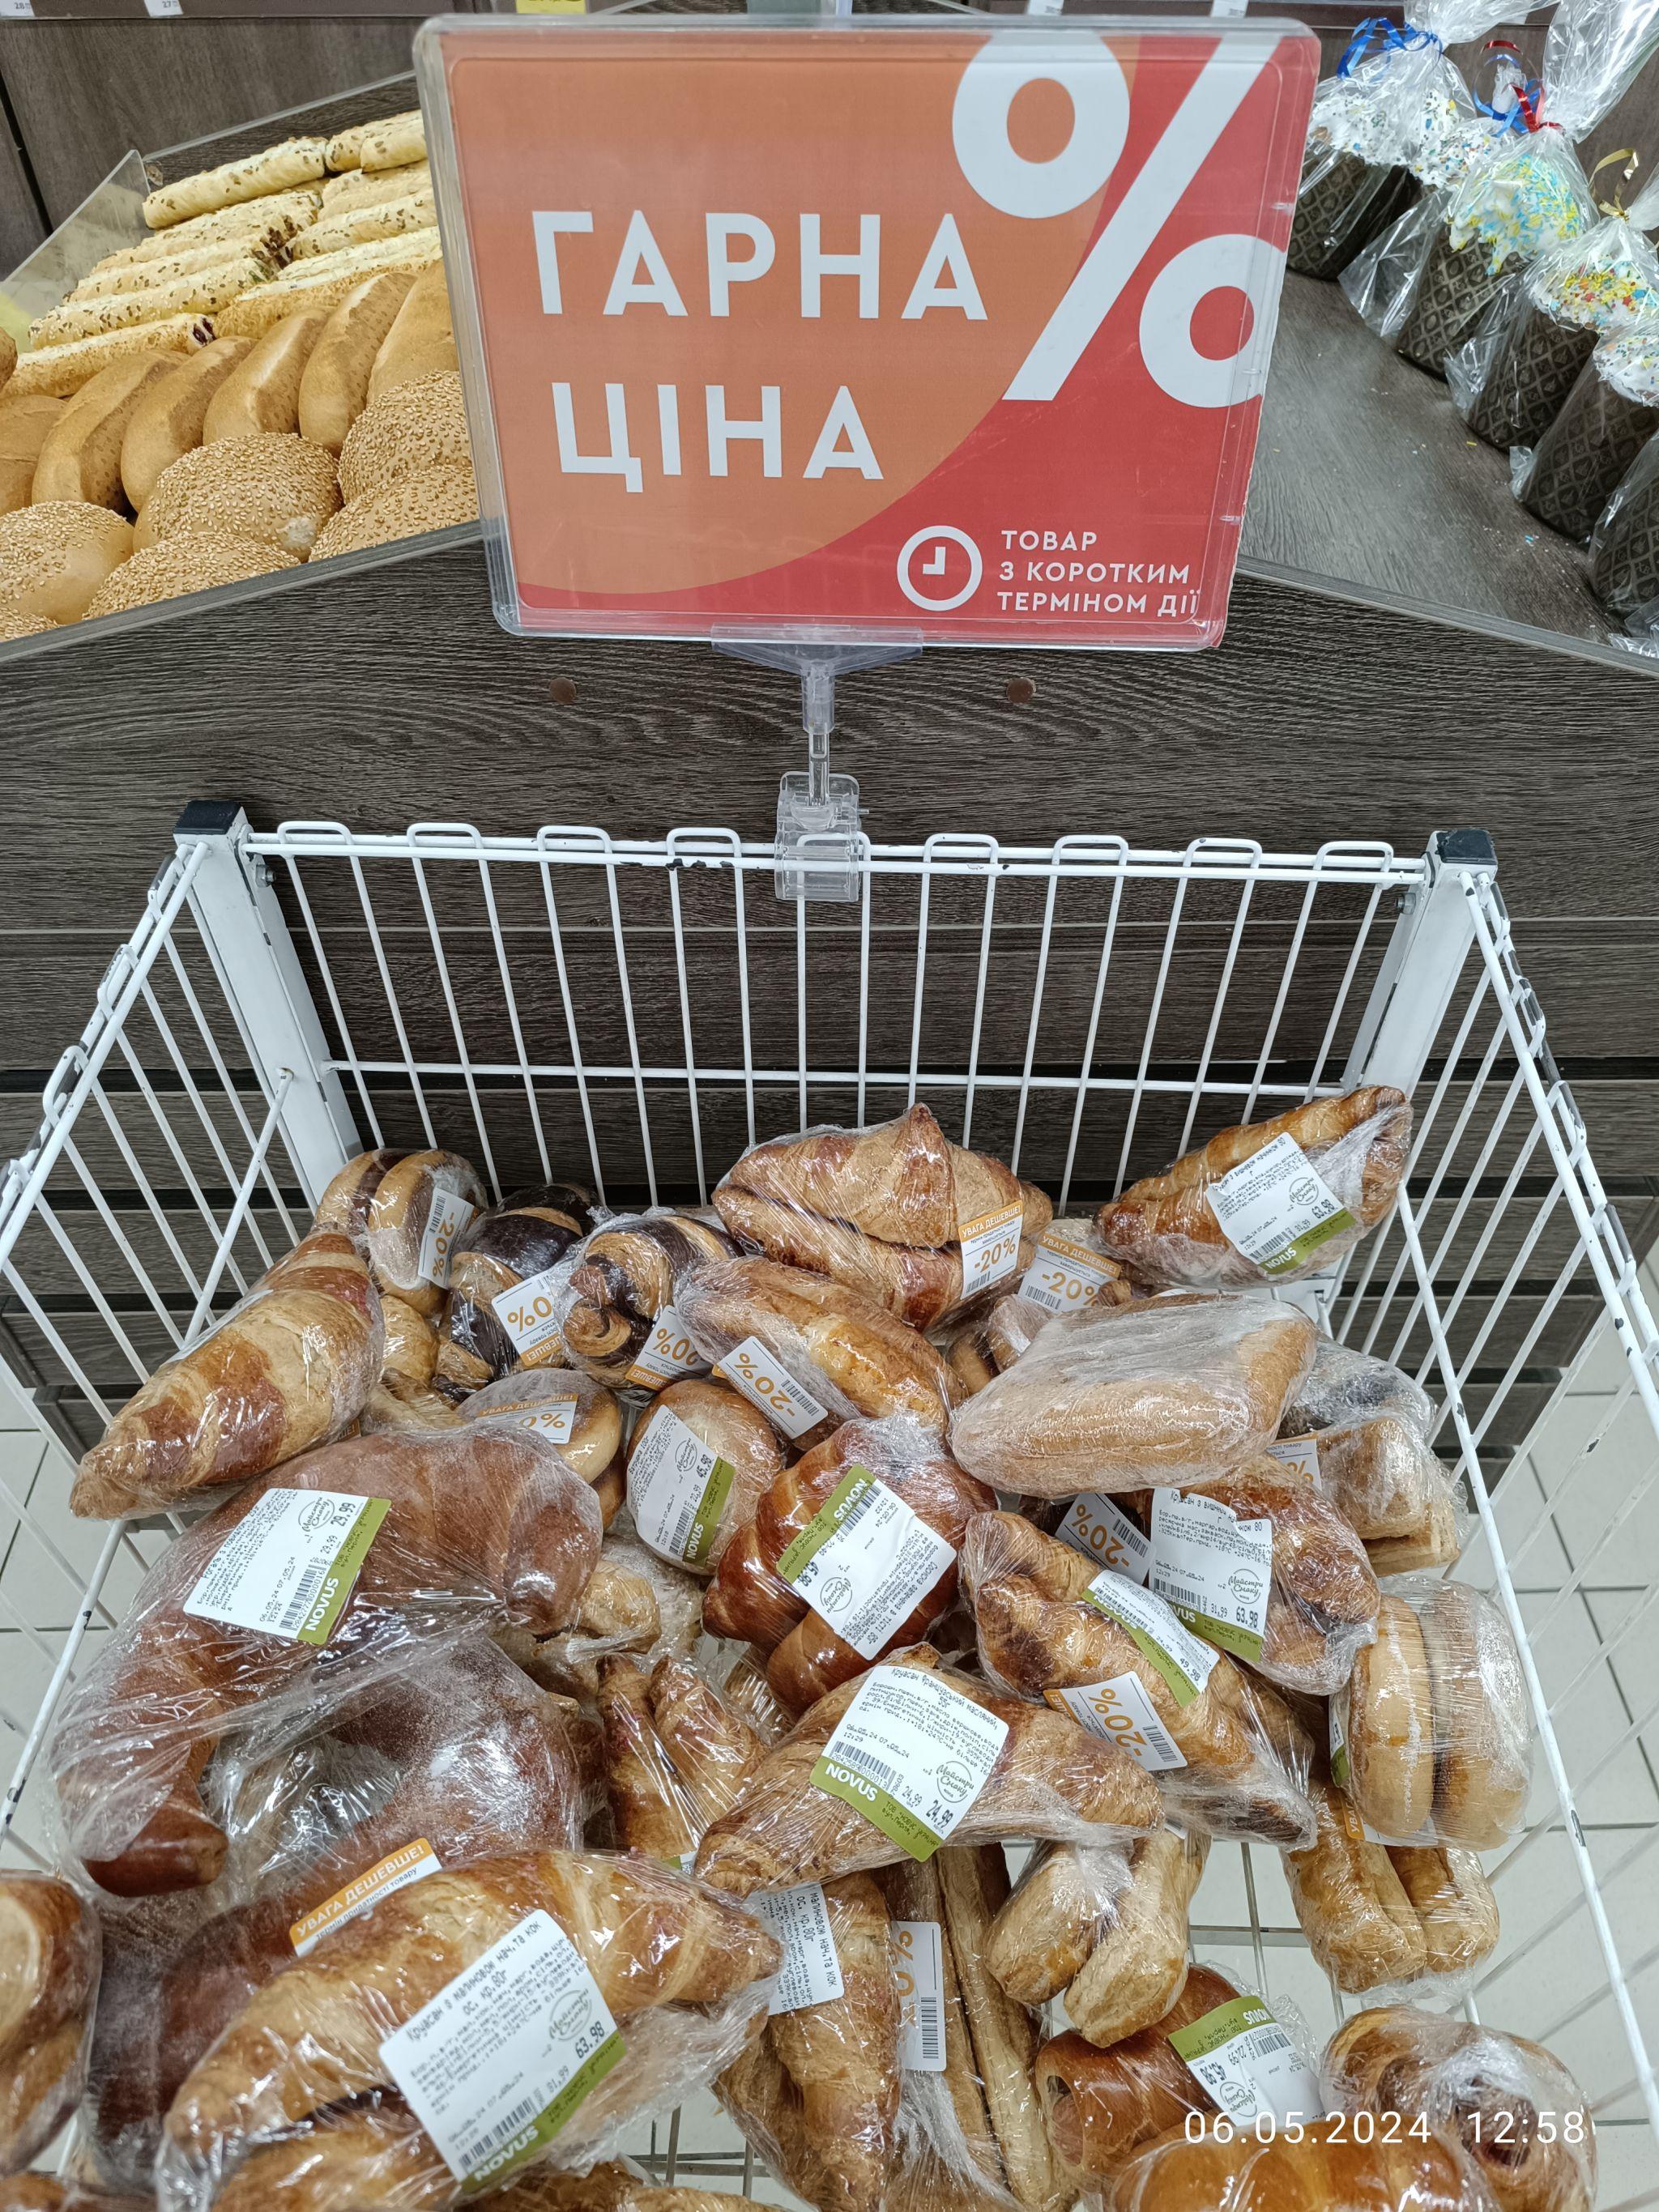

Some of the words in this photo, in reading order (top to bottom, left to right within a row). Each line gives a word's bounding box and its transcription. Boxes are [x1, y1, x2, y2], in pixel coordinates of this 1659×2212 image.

[531, 210, 988, 322] ГАРНА
[551, 381, 885, 494] ЦІНА
[1001, 528, 1098, 552] ТОВАР
[1000, 561, 1015, 582] З
[1026, 560, 1190, 585] КОРОТКИМ
[996, 590, 1147, 613] ТЕРМІНОМ
[1158, 590, 1198, 618] ДІЇ
[961, 1221, 984, 1238] УВАГА
[984, 1204, 1021, 1229] ДЕШЕВШЕ!
[1311, 1197, 1335, 1220] 63.98
[430, 1210, 457, 1278] -20%
[972, 1234, 1020, 1274] -20%
[1041, 1235, 1070, 1253] УВАГА
[1069, 1247, 1117, 1274] ДЕШЕВШЕ!
[1265, 1246, 1297, 1270] NOVUS
[1038, 1266, 1102, 1309] -20%
[505, 1293, 555, 1335] 0%
[650, 1326, 702, 1368] 20%
[730, 1351, 801, 1420] -20%
[481, 1404, 514, 1415] УВАГА
[518, 1413, 565, 1431] 0%
[300, 1495, 323, 1532] Майстри
[831, 1477, 868, 1521] NOVUS
[873, 1497, 889, 1515] 12:22
[309, 1500, 330, 1528] Смаку
[319, 1532, 338, 1555] 29.99
[330, 1498, 356, 1529] 29.99
[873, 1501, 896, 1528] 06.05.24
[685, 1521, 705, 1560] NOVUS
[1064, 1502, 1137, 1573] -20%
[795, 1558, 820, 1588] 45.98
[915, 1560, 938, 1586] Сосиска
[1227, 1575, 1263, 1589] Майстри
[258, 1589, 279, 1622] 06.05.24
[275, 1555, 296, 1589] 07.05.24
[821, 1579, 844, 1606] Смаку
[825, 1577, 852, 1613] Майстри
[893, 1583, 918, 1610] запечена
[1233, 1582, 1259, 1597] Смаку
[304, 1575, 340, 1633] NOVUS
[1175, 1607, 1196, 1622] VUS
[1235, 1606, 1260, 1628] 63.98
[875, 1614, 891, 1634] тісті
[1178, 1657, 1201, 1681] 49.98
[890, 1667, 919, 1681] Круасан
[920, 1674, 966, 1707] Французький
[937, 1696, 952, 1709] 55г
[843, 1731, 864, 1743] 12:29
[1088, 1685, 1150, 1760] -20%
[825, 1762, 880, 1802] NOVUS
[935, 1762, 975, 1791] Майстри
[939, 1774, 967, 1798] Смаку
[885, 1801, 897, 1813] ТОВ
[901, 1784, 923, 1808] 24.99
[924, 1797, 953, 1831] 24.99
[296, 1899, 343, 1937] УВАГА
[342, 1843, 424, 1905] ДЕШЕВШЕ!
[342, 1884, 390, 1921] придатності
[389, 1866, 419, 1888] товару
[795, 1895, 807, 1909] ос.
[809, 1891, 825, 1935] малиновою
[797, 1914, 817, 1943] кр.80г
[819, 1937, 832, 1967] нач.та
[405, 2005, 445, 2044] Круасан
[452, 1958, 497, 2001] малиновою
[495, 1933, 526, 1963] нач.та
[524, 1919, 542, 1937] кок
[825, 1971, 837, 1987] кок
[461, 1997, 480, 2016] ос.
[1242, 2006, 1270, 2025] NOVUS
[571, 2020, 608, 2059] 63.98
[1226, 2044, 1247, 2066] 22.99
[1199, 2060, 1227, 2087] 45.98
[471, 2124, 541, 2183] NOVUS
